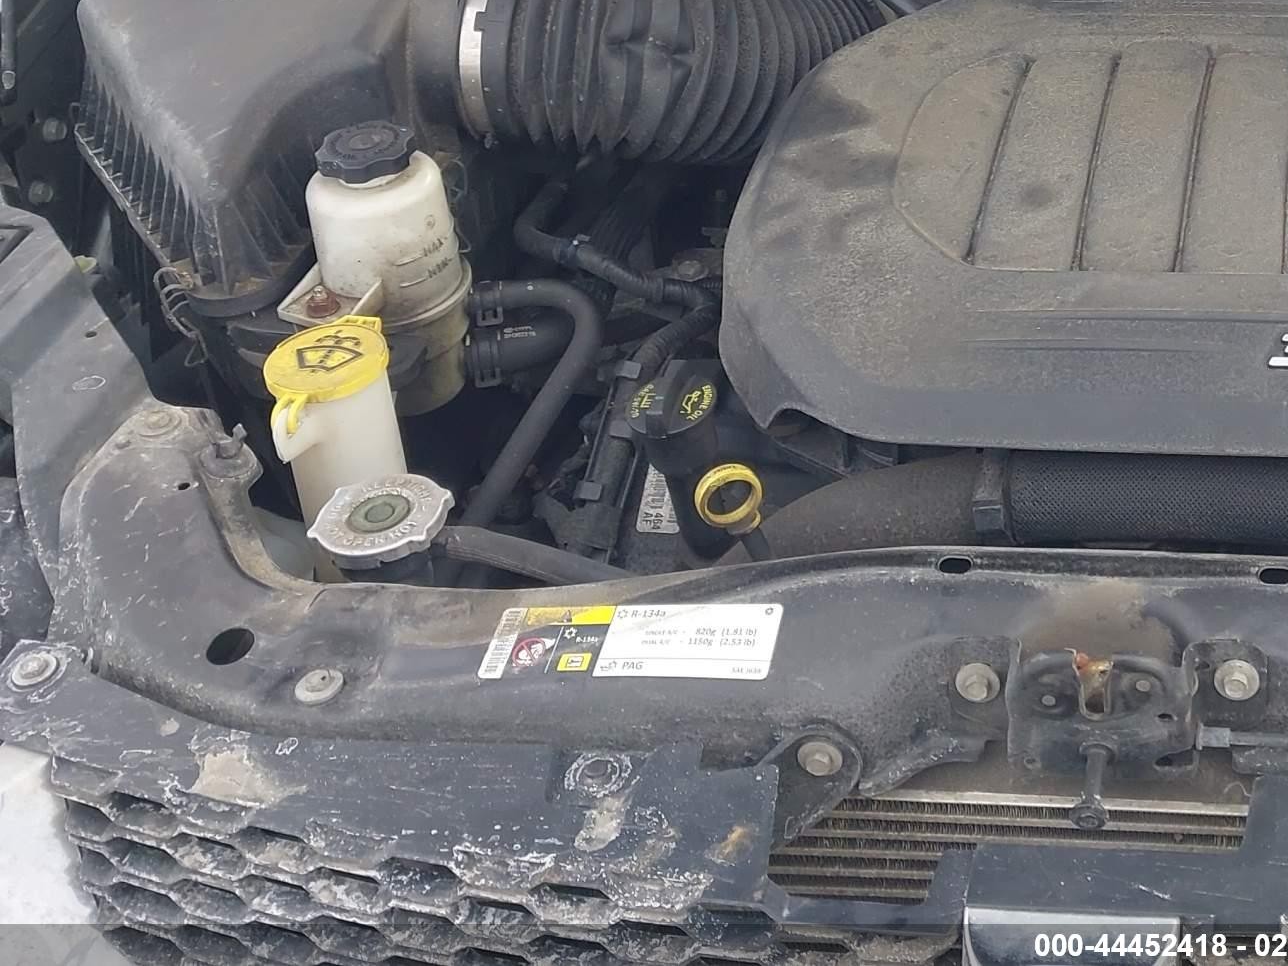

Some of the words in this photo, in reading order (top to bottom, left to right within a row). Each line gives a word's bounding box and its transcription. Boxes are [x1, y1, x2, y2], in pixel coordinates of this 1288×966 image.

[699, 384, 713, 410] ENGINE
[686, 410, 703, 422] OIL
[631, 609, 667, 619] R-134a
[695, 628, 716, 637] 820g
[745, 628, 757, 637] lb)
[688, 638, 713, 647] 1150g
[743, 639, 756, 647] lb)
[622, 661, 643, 671] PAG
